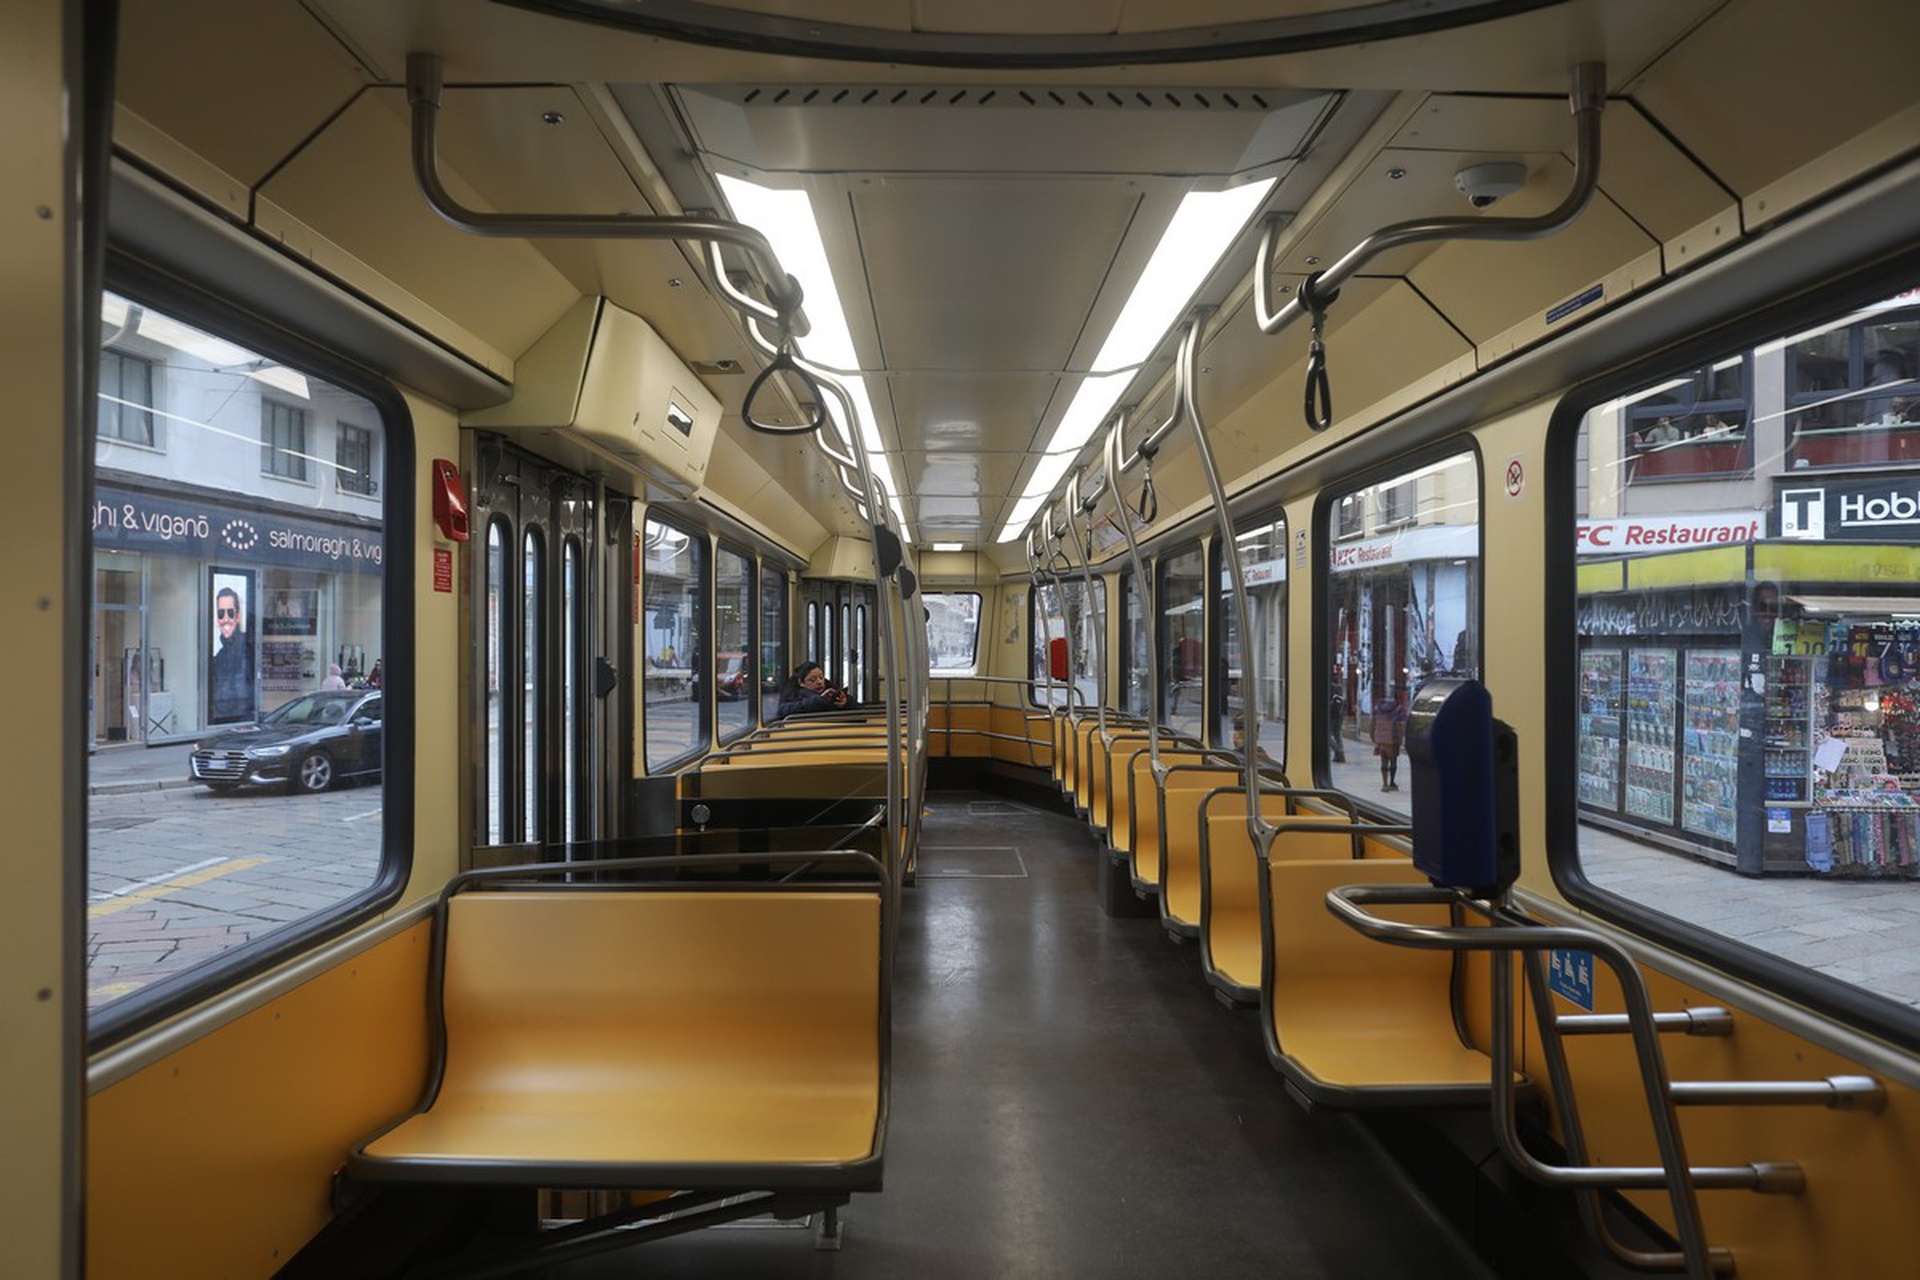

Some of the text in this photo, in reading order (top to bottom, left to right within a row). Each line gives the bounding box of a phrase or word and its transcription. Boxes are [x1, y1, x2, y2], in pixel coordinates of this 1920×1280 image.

[122, 504, 139, 530] &
[1840, 491, 1920, 521] Hob
[269, 529, 350, 560] salmoiraghi
[352, 538, 362, 558] &
[1625, 520, 1758, 545] Restaurant
